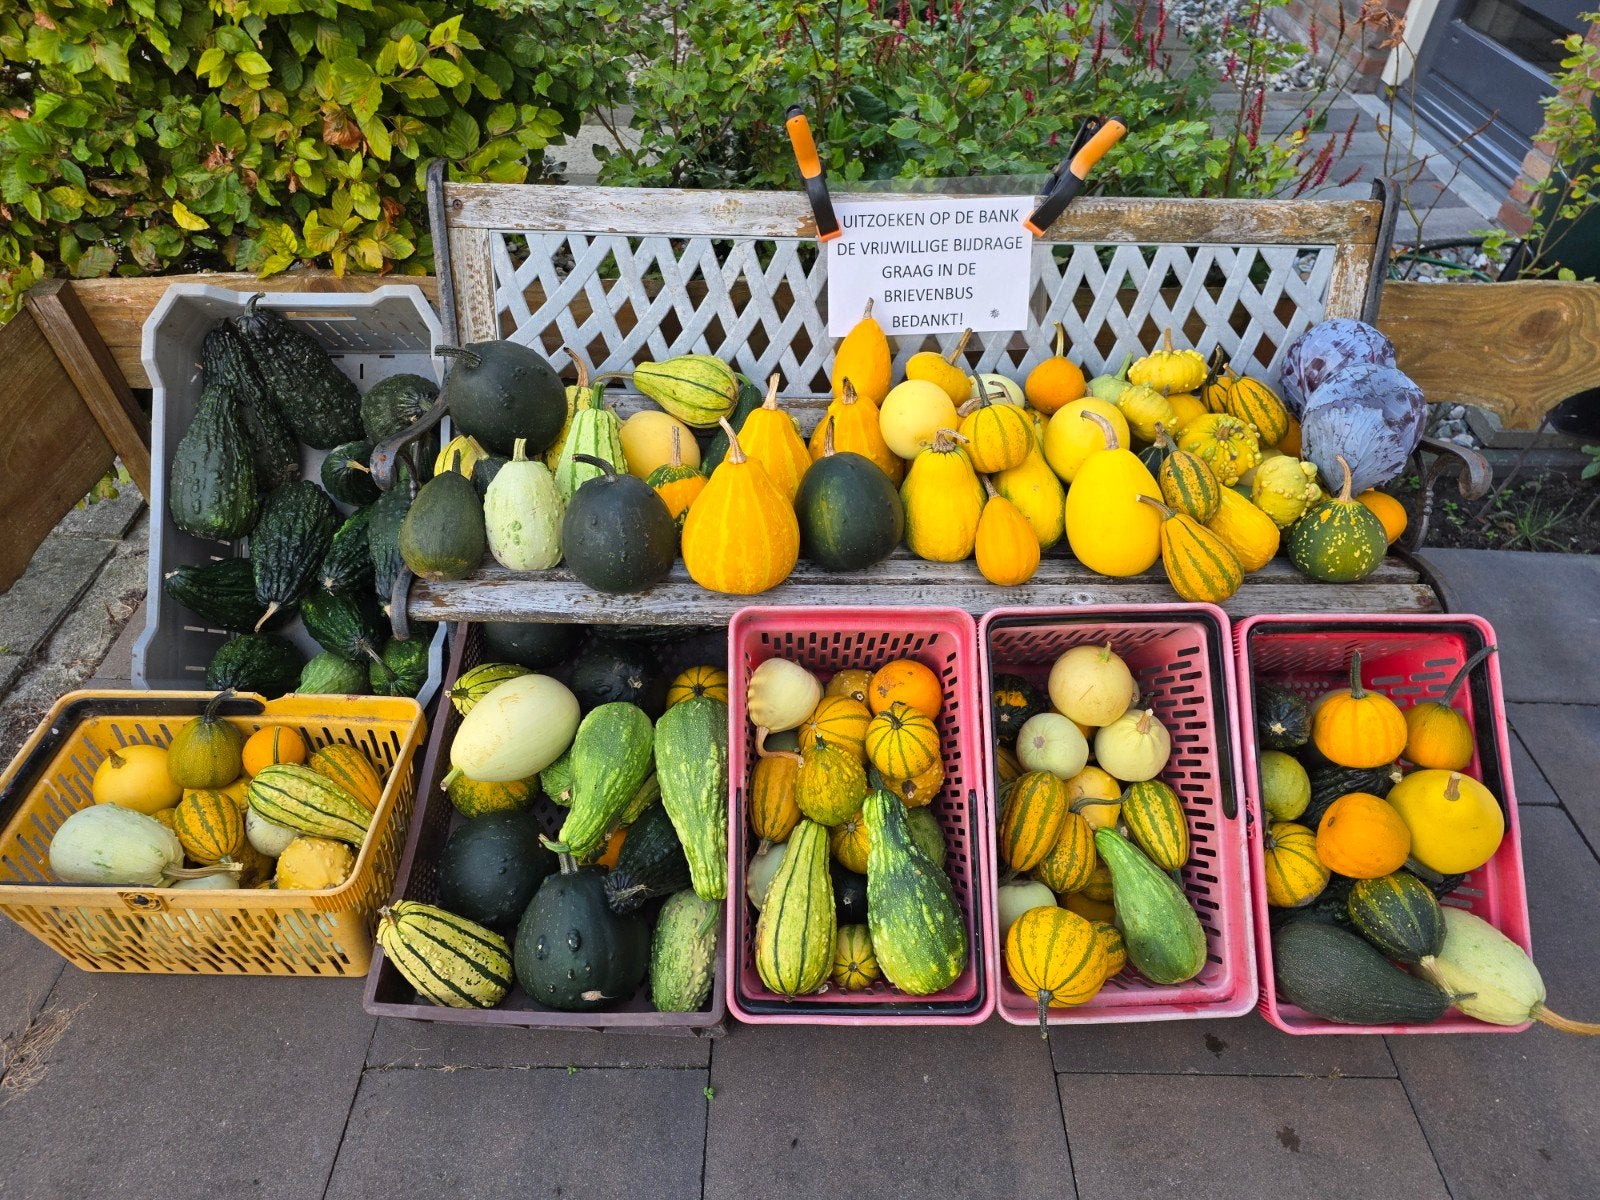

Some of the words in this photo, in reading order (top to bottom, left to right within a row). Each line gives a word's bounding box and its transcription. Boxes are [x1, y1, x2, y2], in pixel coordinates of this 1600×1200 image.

[842, 212, 925, 228] UITZOEKEN
[929, 211, 950, 226] OP
[955, 210, 974, 225] DE
[979, 208, 1019, 224] BANK
[837, 242, 856, 256] DE
[860, 239, 949, 255] VRIJWILLIGE
[953, 236, 1023, 252] BIJDRAGE
[882, 264, 933, 279] GRAAG
[938, 263, 953, 277] IN
[957, 262, 976, 276] DE
[884, 286, 973, 303] BRIEVENBUS
[892, 313, 963, 328] BEDANKT!
